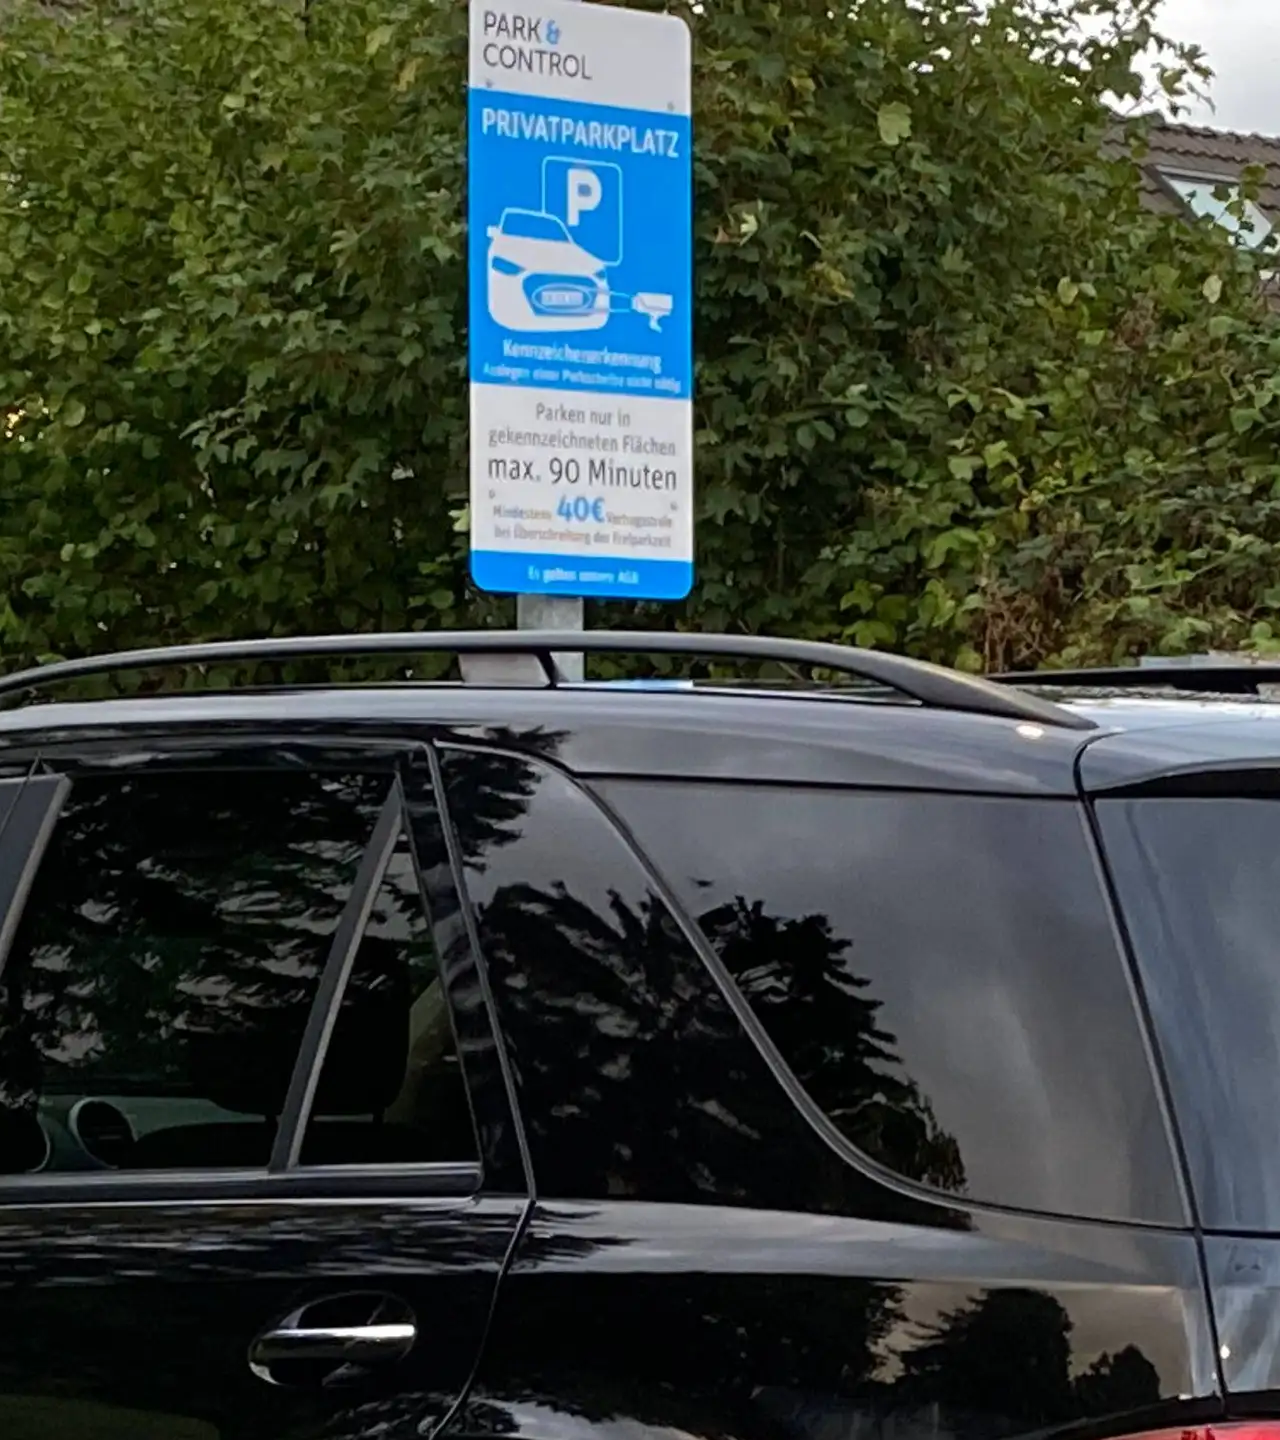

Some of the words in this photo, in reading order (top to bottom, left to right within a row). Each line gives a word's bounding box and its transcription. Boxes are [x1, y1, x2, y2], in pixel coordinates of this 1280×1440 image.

[483, 10, 543, 43] PARK
[482, 43, 593, 81] CONTROL
[481, 107, 681, 158] PRIVATPARKPLATZ
[536, 402, 586, 424] Parken
[590, 409, 612, 425] nur
[618, 409, 631, 428] in
[488, 426, 619, 452] gekennzeichneten
[622, 434, 676, 456] Flächen
[488, 458, 541, 482] max.
[548, 456, 580, 484] 90
[588, 458, 677, 490] Minuten
[556, 495, 606, 523] 40€
